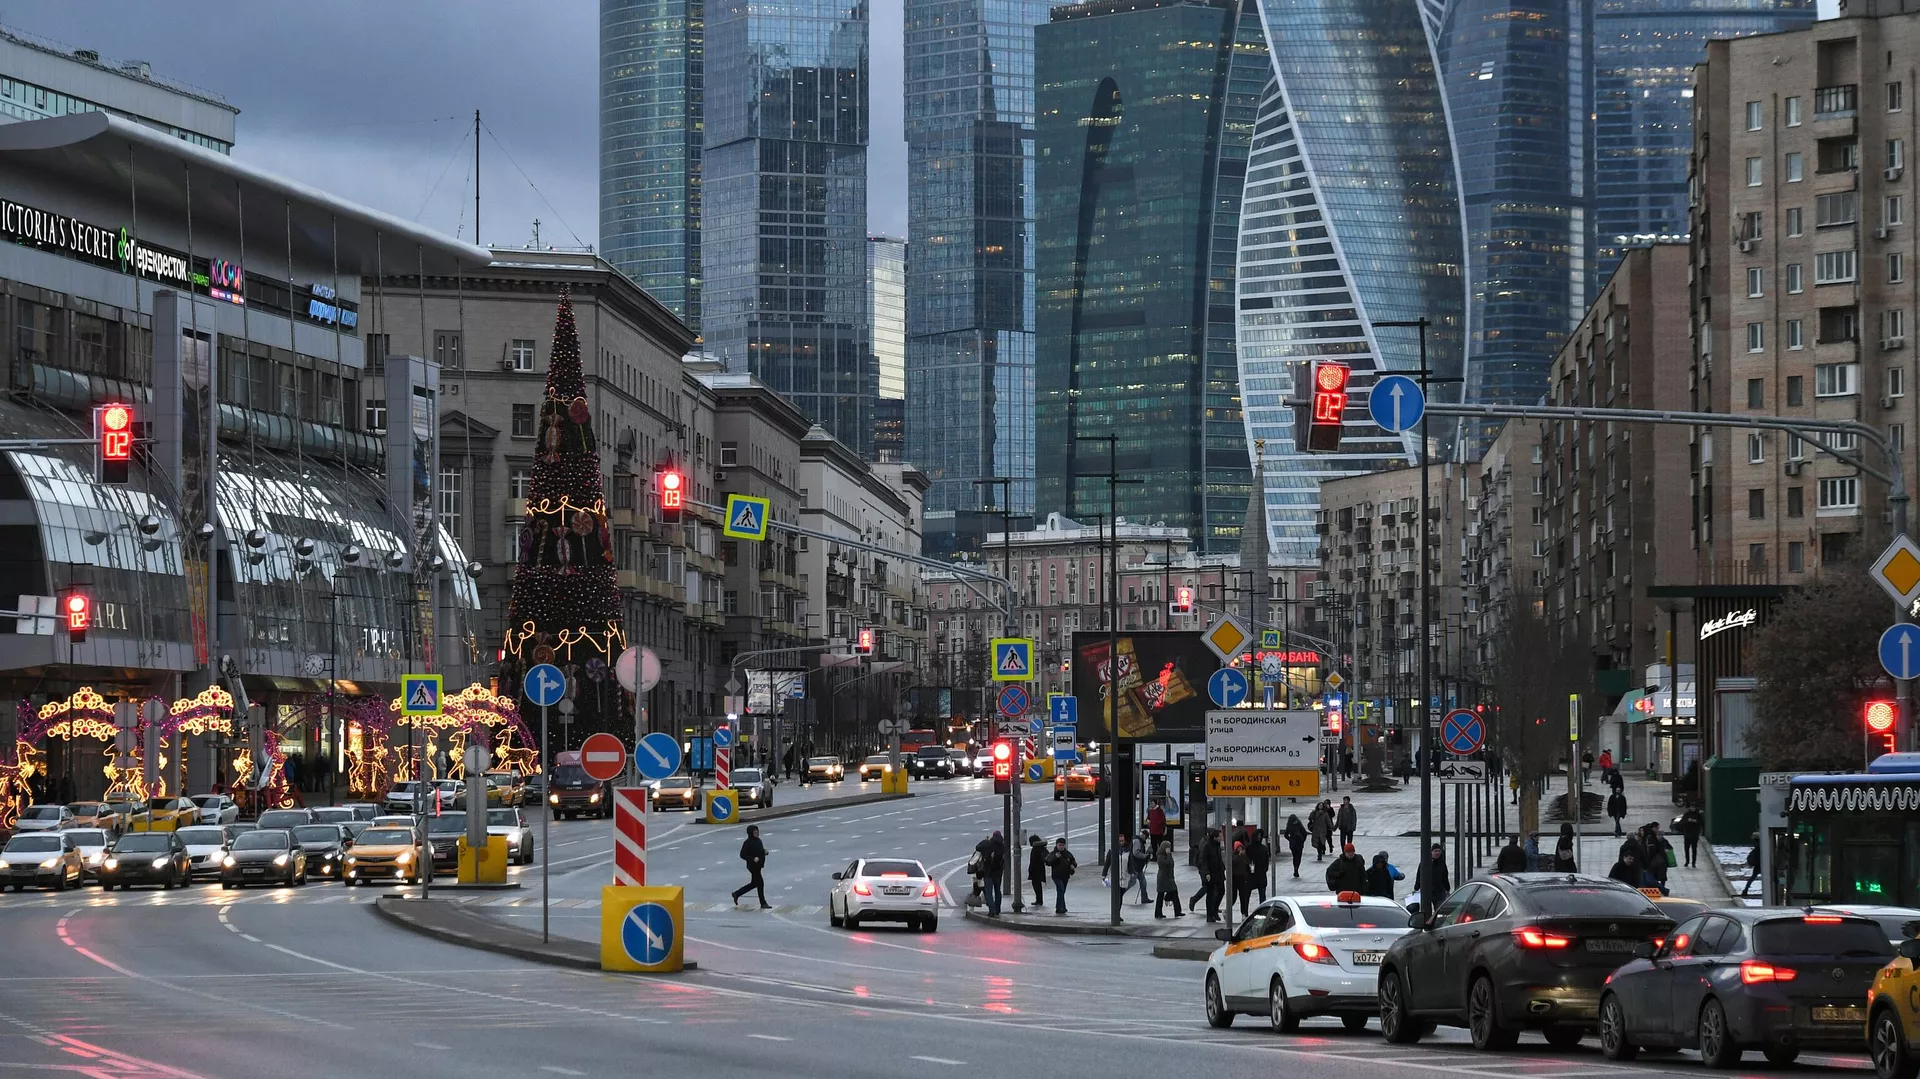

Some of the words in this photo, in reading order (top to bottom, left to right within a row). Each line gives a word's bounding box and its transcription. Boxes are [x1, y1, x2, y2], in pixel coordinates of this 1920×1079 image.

[0, 200, 66, 247] ICTORIA'S
[70, 217, 116, 261] SECRET
[211, 258, 243, 291] КОСМИ
[1316, 393, 1342, 420] 02
[106, 433, 129, 457] 02
[664, 490, 680, 507] 03
[1210, 717, 1221, 725] 1-я
[1224, 717, 1287, 725] БОРОДИНСКАЯ
[1209, 726, 1233, 735] улица
[1224, 745, 1287, 754] БОРОДИНСКАЯ
[1288, 750, 1300, 758] 0.3
[1209, 755, 1233, 763] улица
[1221, 783, 1247, 791] жилой
[1248, 784, 1281, 792] квартал
